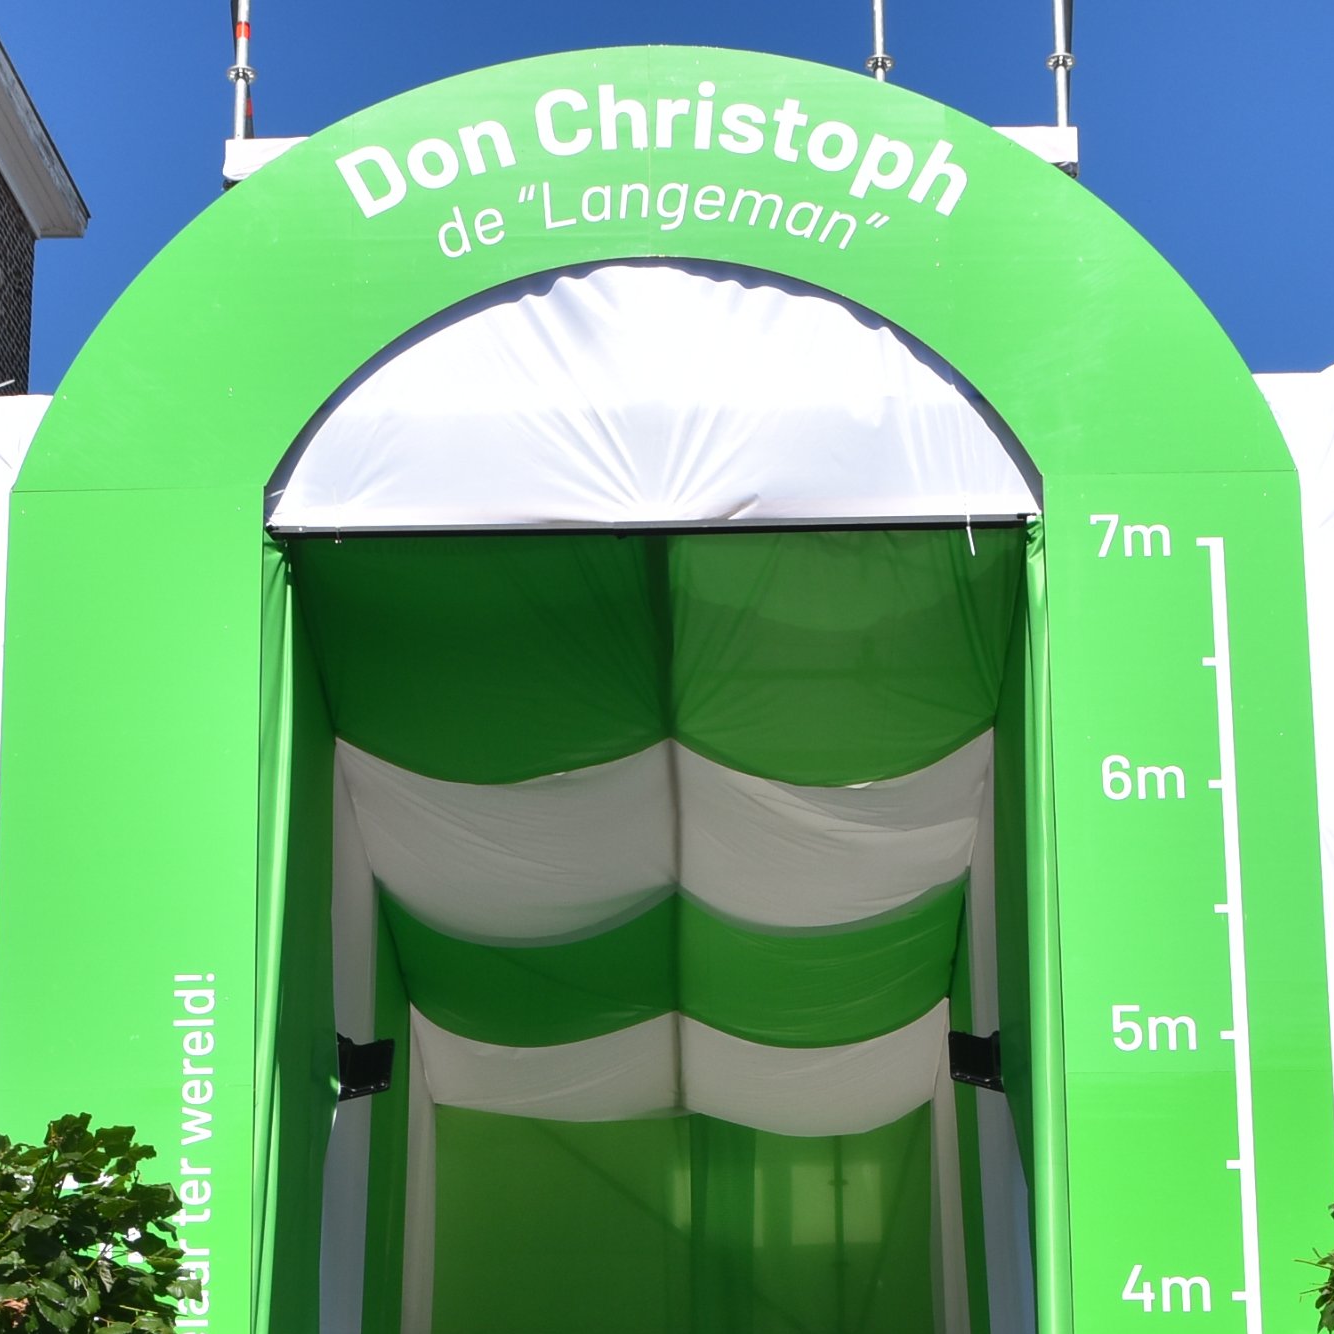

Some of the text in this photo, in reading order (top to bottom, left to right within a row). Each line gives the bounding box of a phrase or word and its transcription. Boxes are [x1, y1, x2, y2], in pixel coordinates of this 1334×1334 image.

[334, 80, 968, 219] Don Christoph
[437, 205, 506, 258] de
[1089, 513, 1172, 558] 7m
[1101, 754, 1186, 801] 6m
[1111, 1004, 1197, 1052] 5m
[172, 972, 216, 1146] wereld!
[172, 1158, 212, 1227] ter
[1121, 1264, 1212, 1313] 4m
